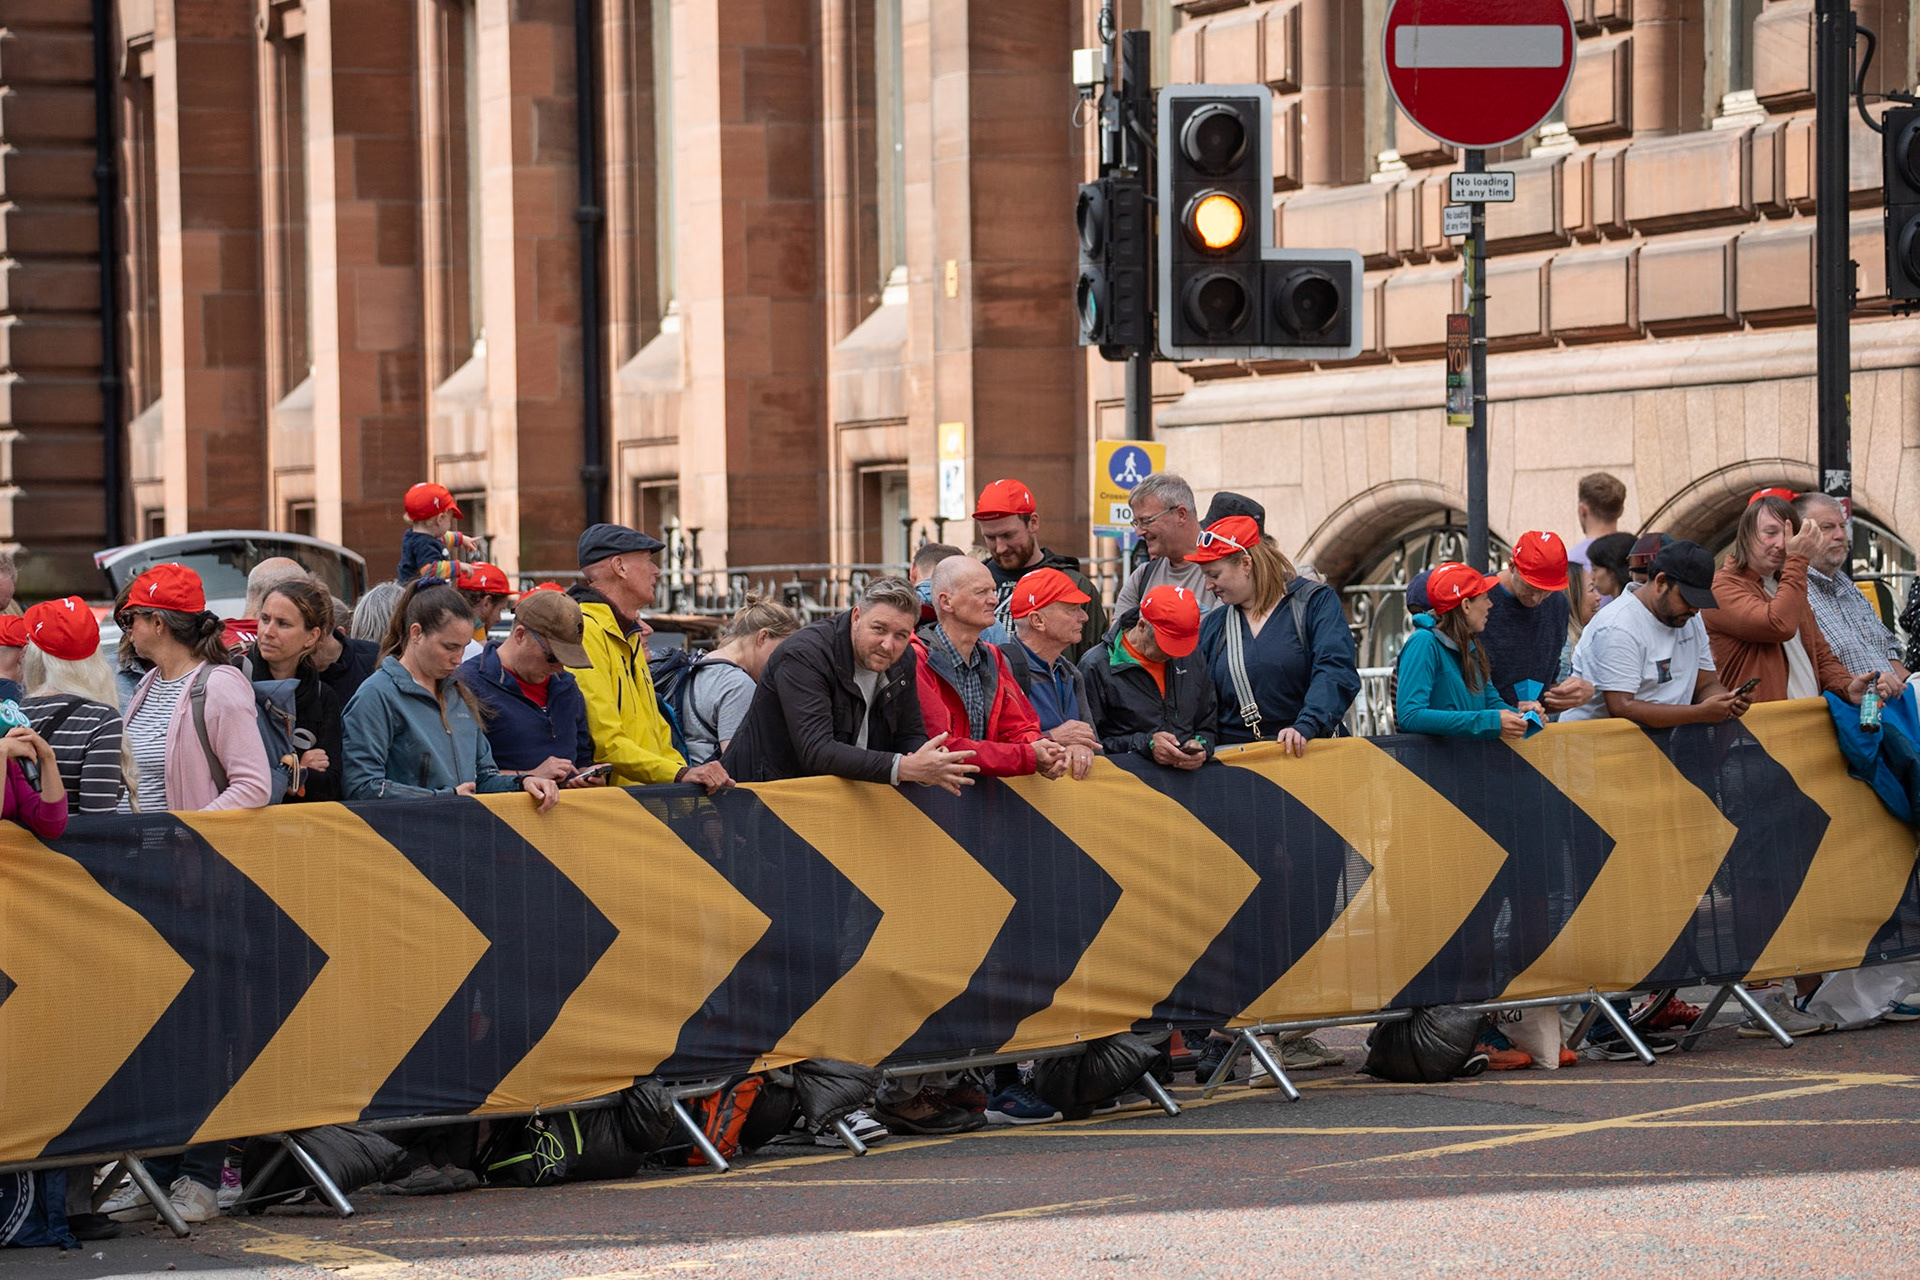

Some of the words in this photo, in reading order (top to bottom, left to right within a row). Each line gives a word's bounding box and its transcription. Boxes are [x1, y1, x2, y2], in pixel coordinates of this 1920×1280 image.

[1456, 177, 1470, 186] No
[1473, 177, 1509, 187] loading
[1455, 188, 1465, 197] at
[1468, 190, 1485, 198] any
[1488, 187, 1510, 197] time
[1448, 334, 1469, 347] BEFORE
[1448, 348, 1470, 372] YOU
